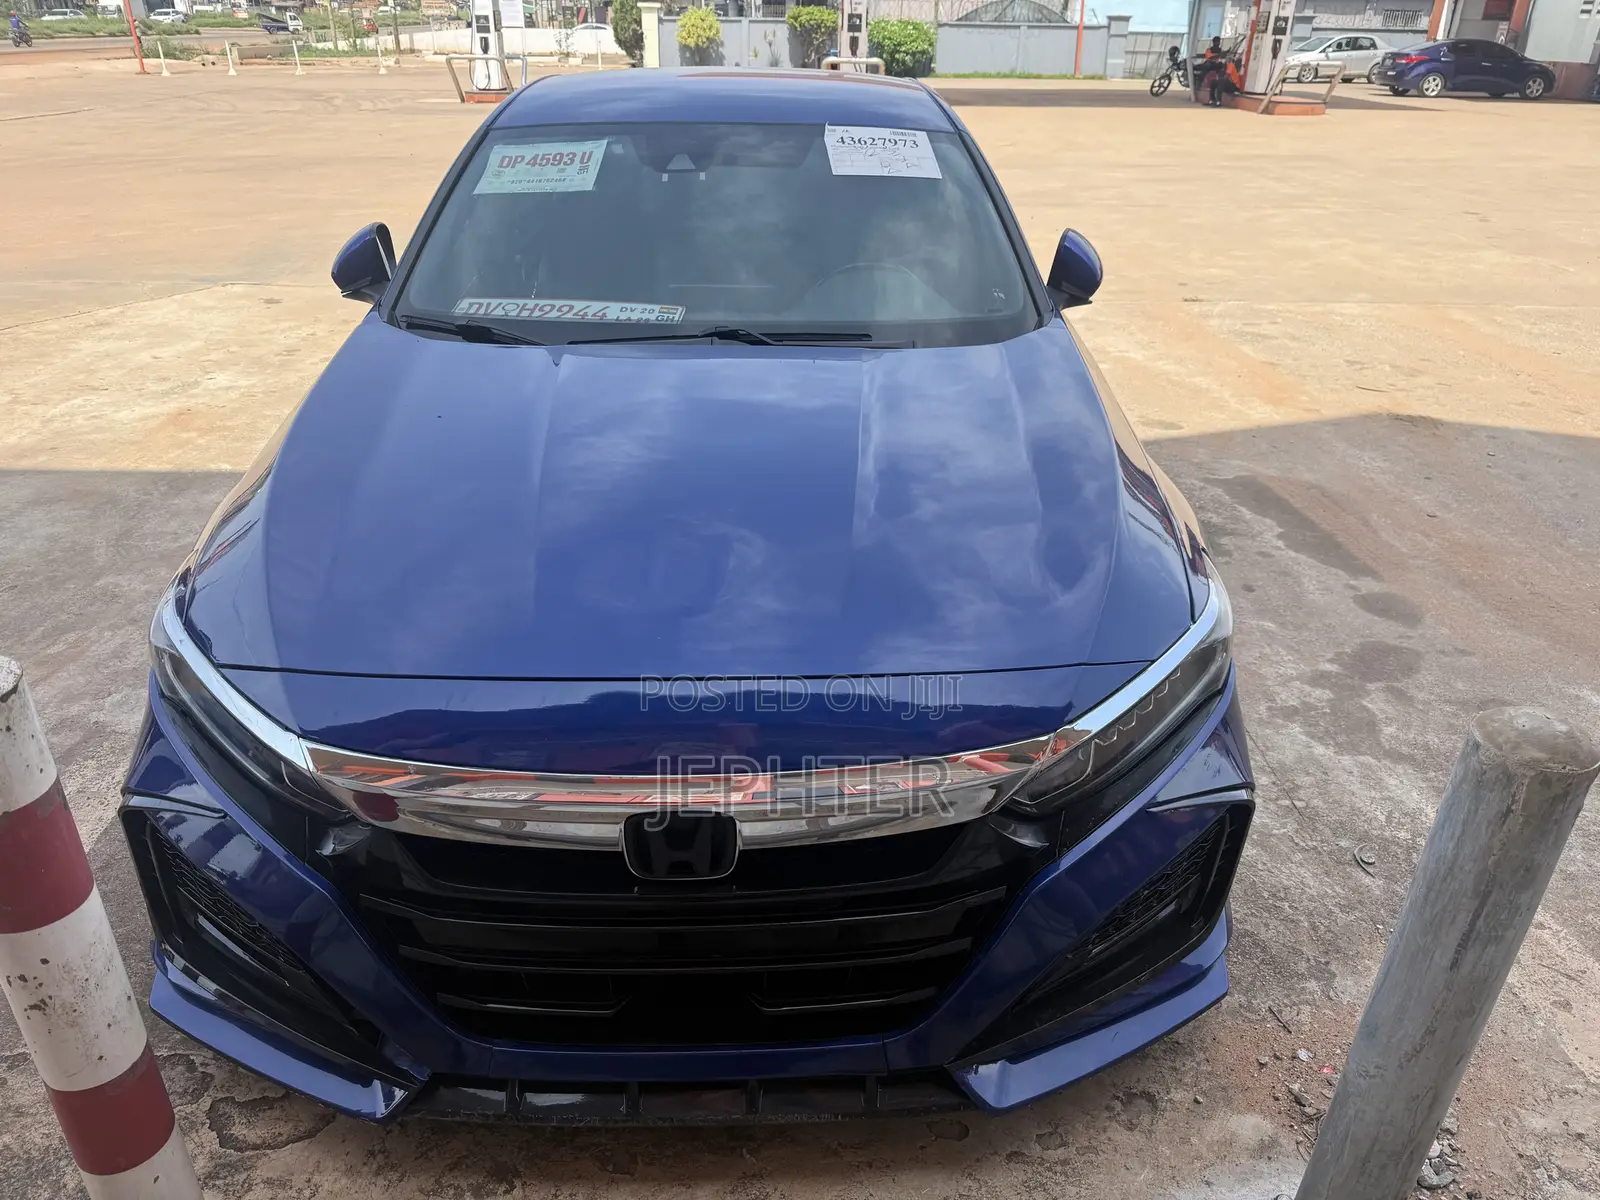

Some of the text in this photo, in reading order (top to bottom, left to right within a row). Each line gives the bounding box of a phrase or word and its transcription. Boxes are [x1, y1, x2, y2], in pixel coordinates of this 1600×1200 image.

[837, 136, 919, 148] 43627973
[498, 151, 594, 168] DP 4593 U
